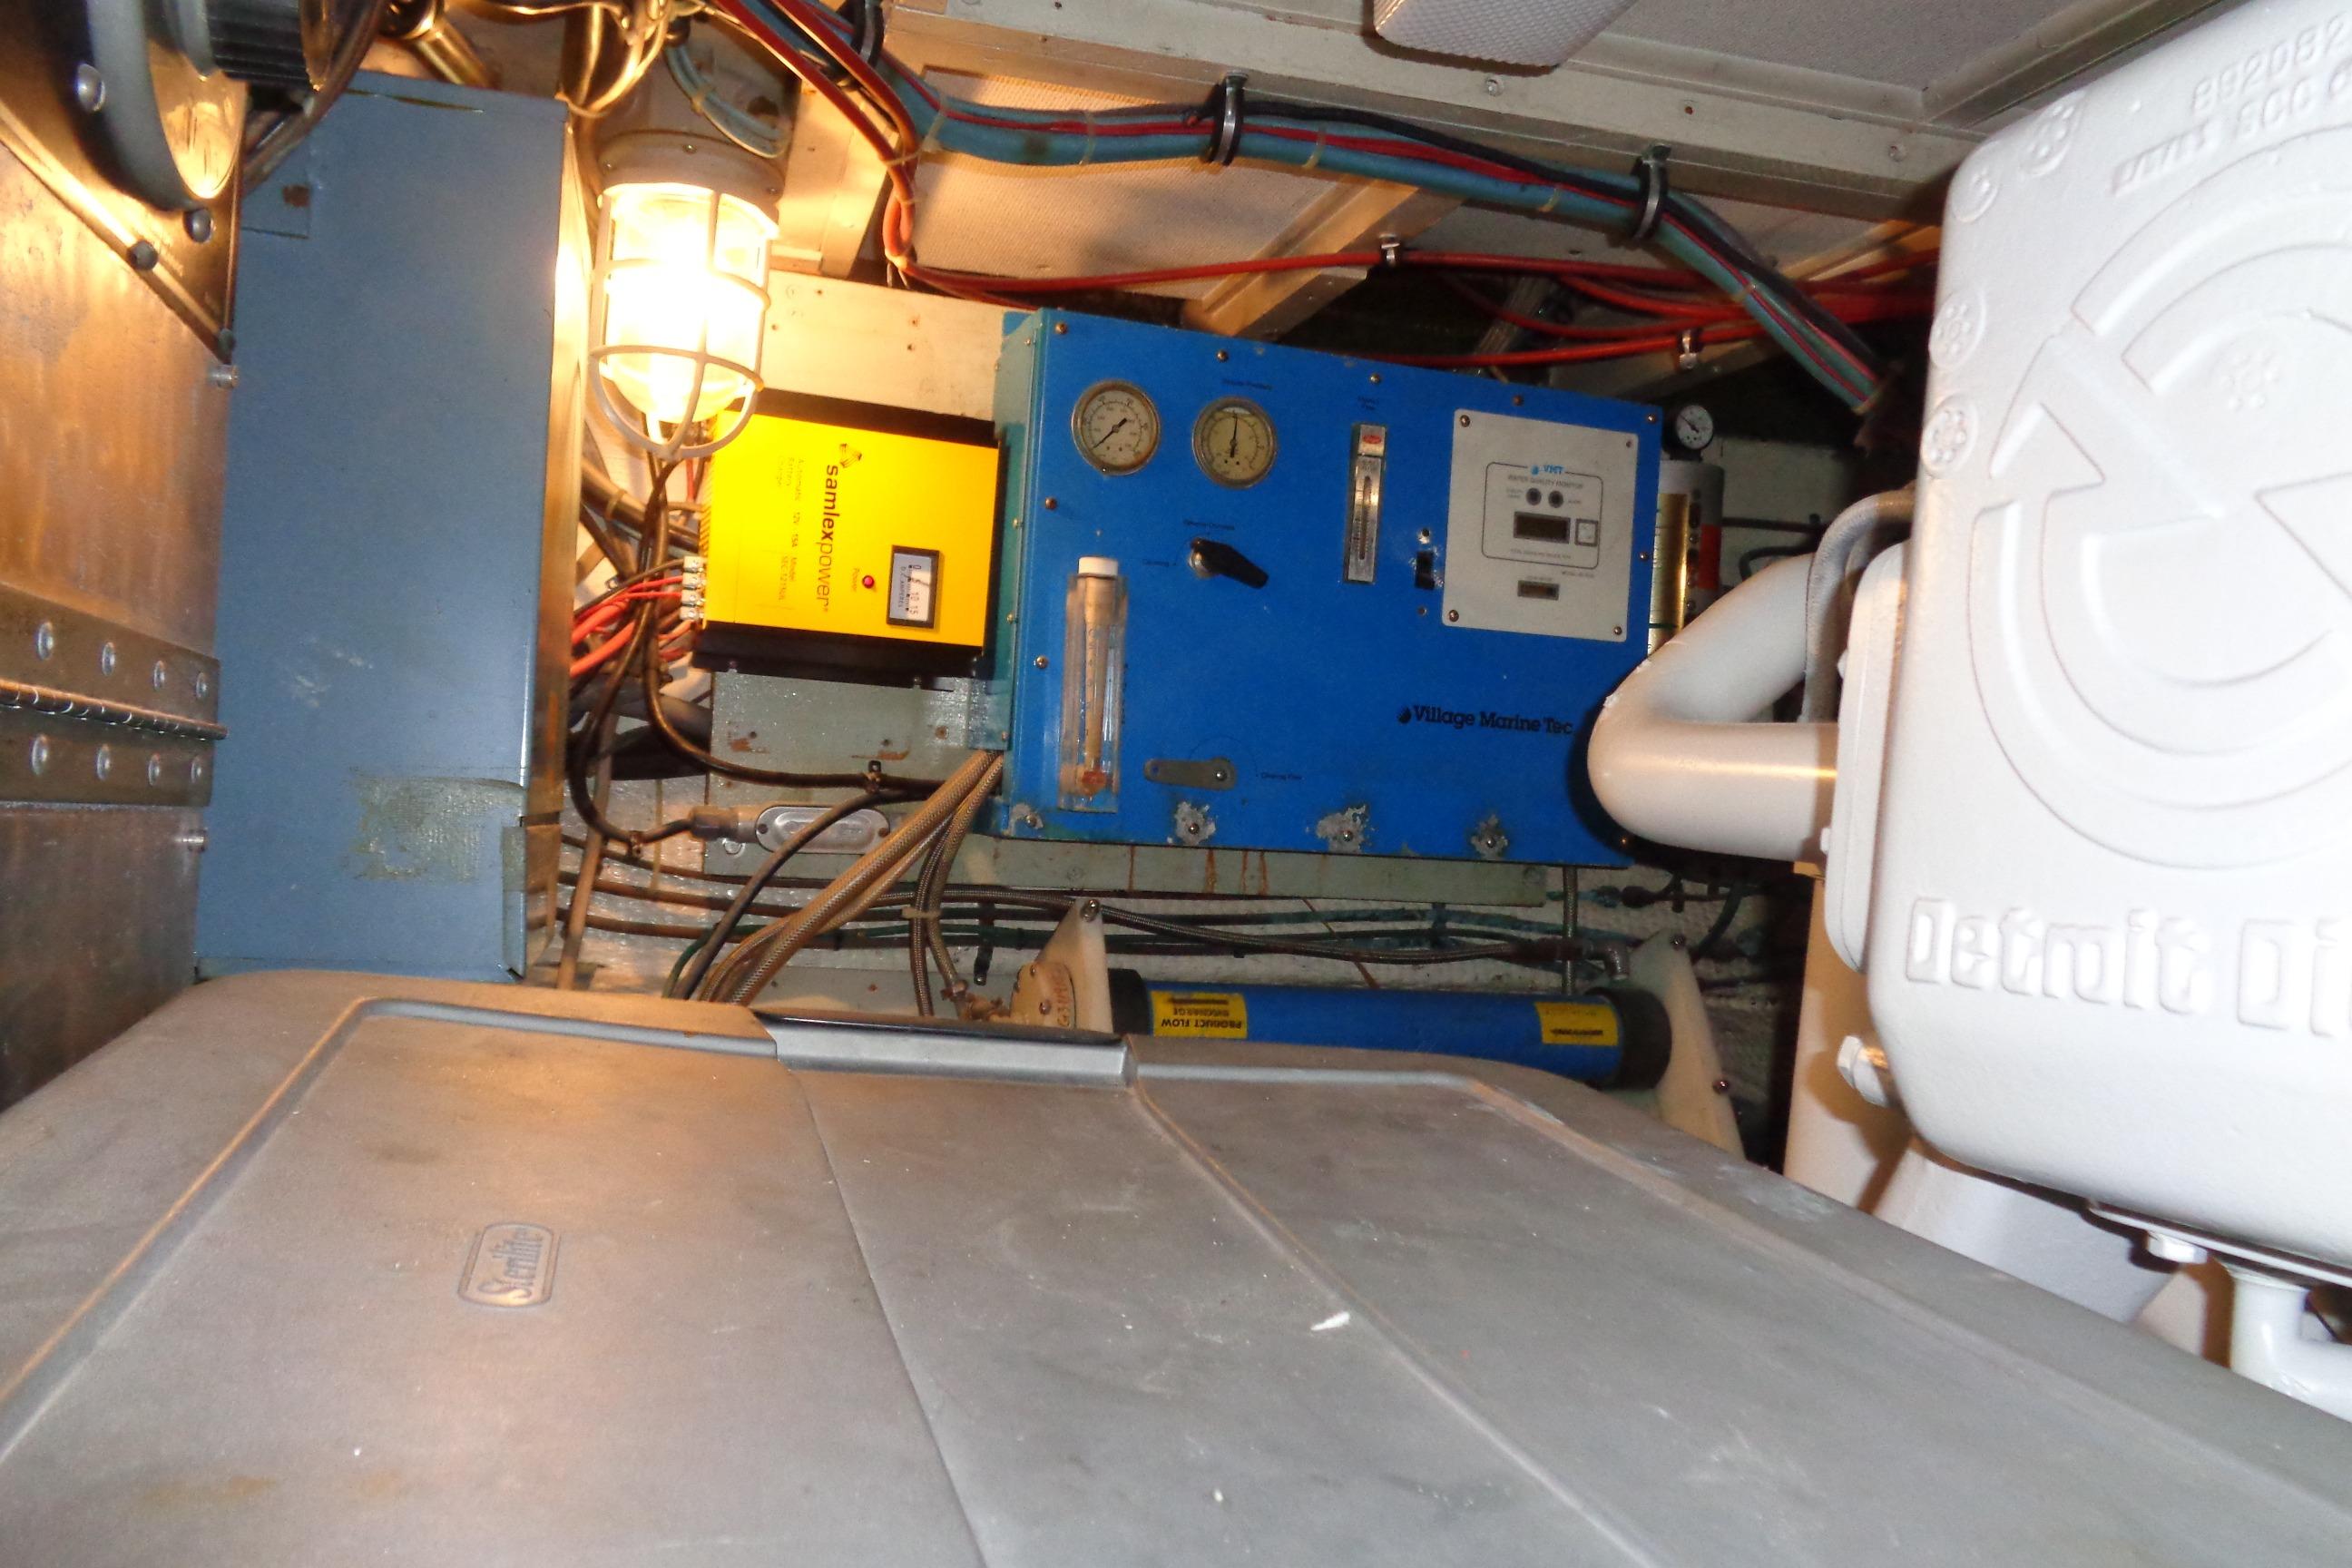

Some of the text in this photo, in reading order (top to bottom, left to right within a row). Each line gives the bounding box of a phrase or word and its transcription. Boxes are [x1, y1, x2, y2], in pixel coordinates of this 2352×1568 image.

[1530, 476, 1555, 486] QUALITY
[1555, 480, 1584, 490] MONITOR
[910, 592, 920, 602] 10
[909, 605, 919, 615] 15
[1414, 704, 1476, 730] Village
[1479, 710, 1541, 732] Marine
[2235, 915, 2352, 1039] Di
[1161, 1018, 1243, 1030] PRODUCT FLOW
